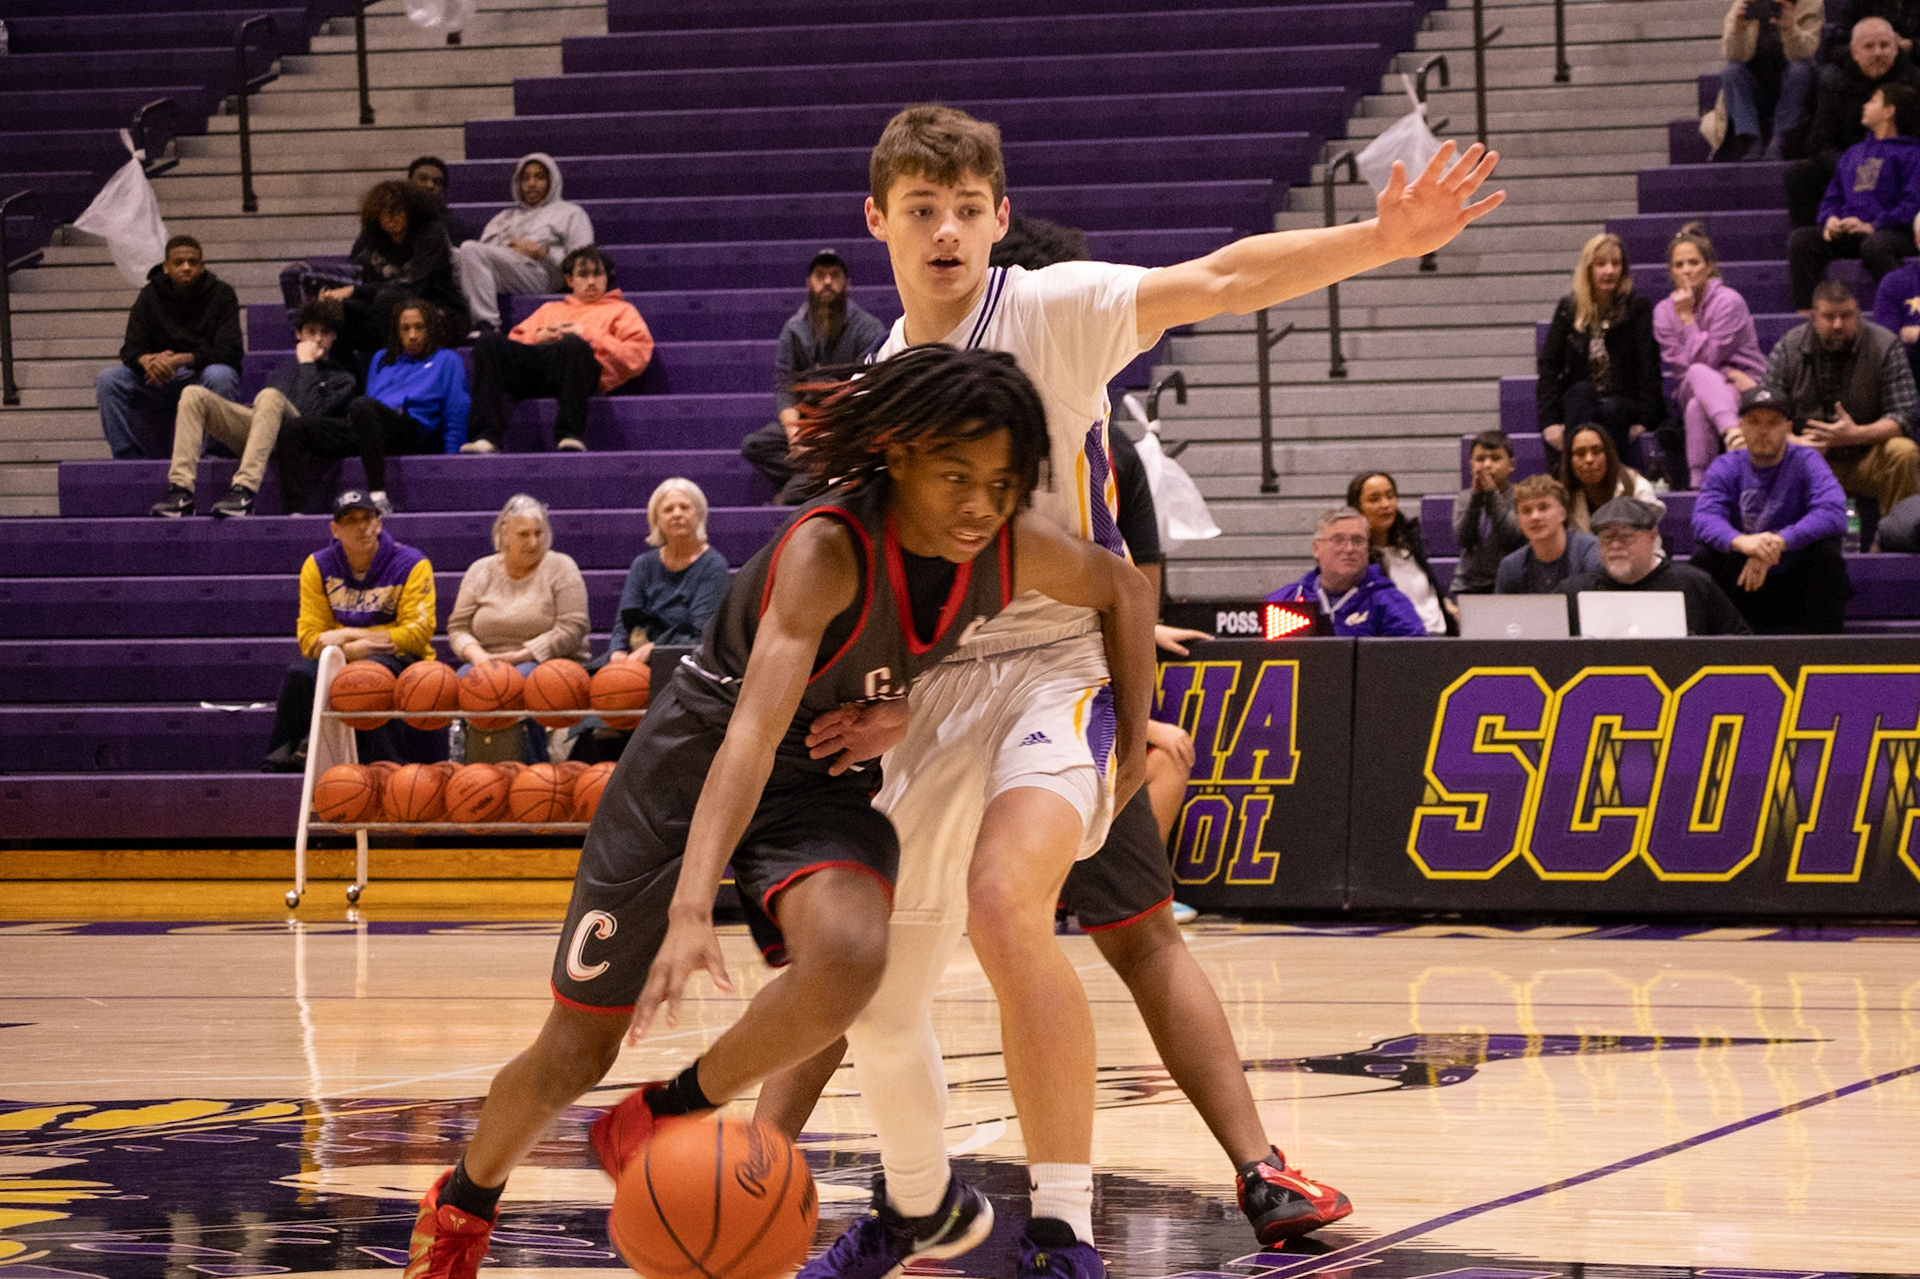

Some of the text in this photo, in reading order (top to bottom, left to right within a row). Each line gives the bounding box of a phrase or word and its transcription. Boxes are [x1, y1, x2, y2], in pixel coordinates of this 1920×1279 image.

[1216, 611, 1263, 633] POSS.
[1406, 665, 1920, 882] SCOT
[1171, 794, 1280, 884] OL
[566, 909, 618, 982] C
